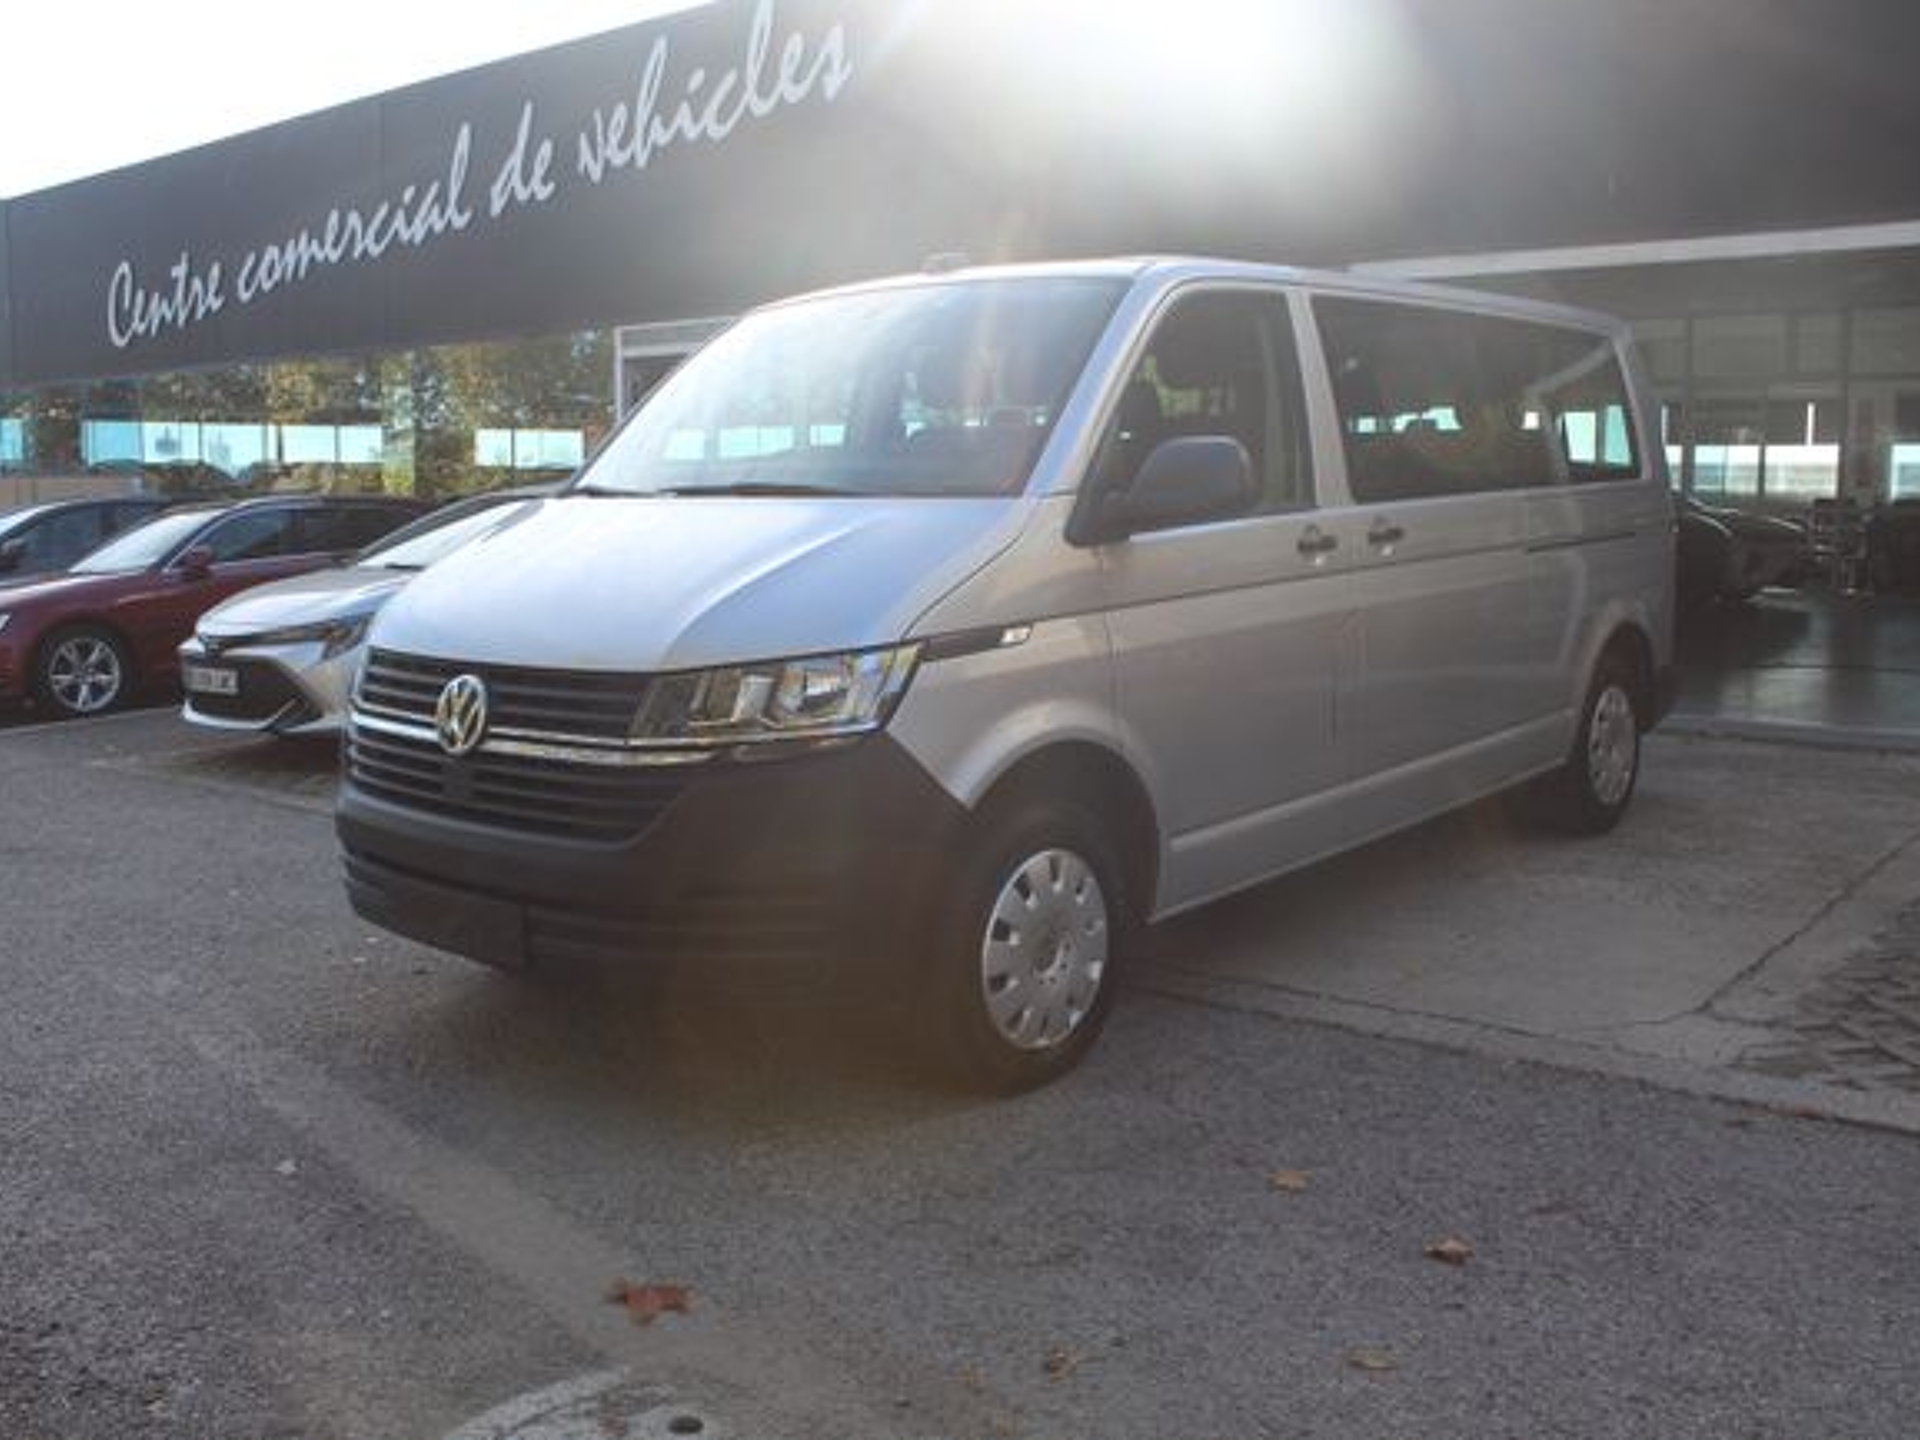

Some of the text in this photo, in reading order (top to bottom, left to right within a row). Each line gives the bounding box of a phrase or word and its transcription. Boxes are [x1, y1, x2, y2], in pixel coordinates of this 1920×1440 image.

[107, 0, 853, 347] Centre comercial de vehicles
[437, 673, 488, 755] VW
